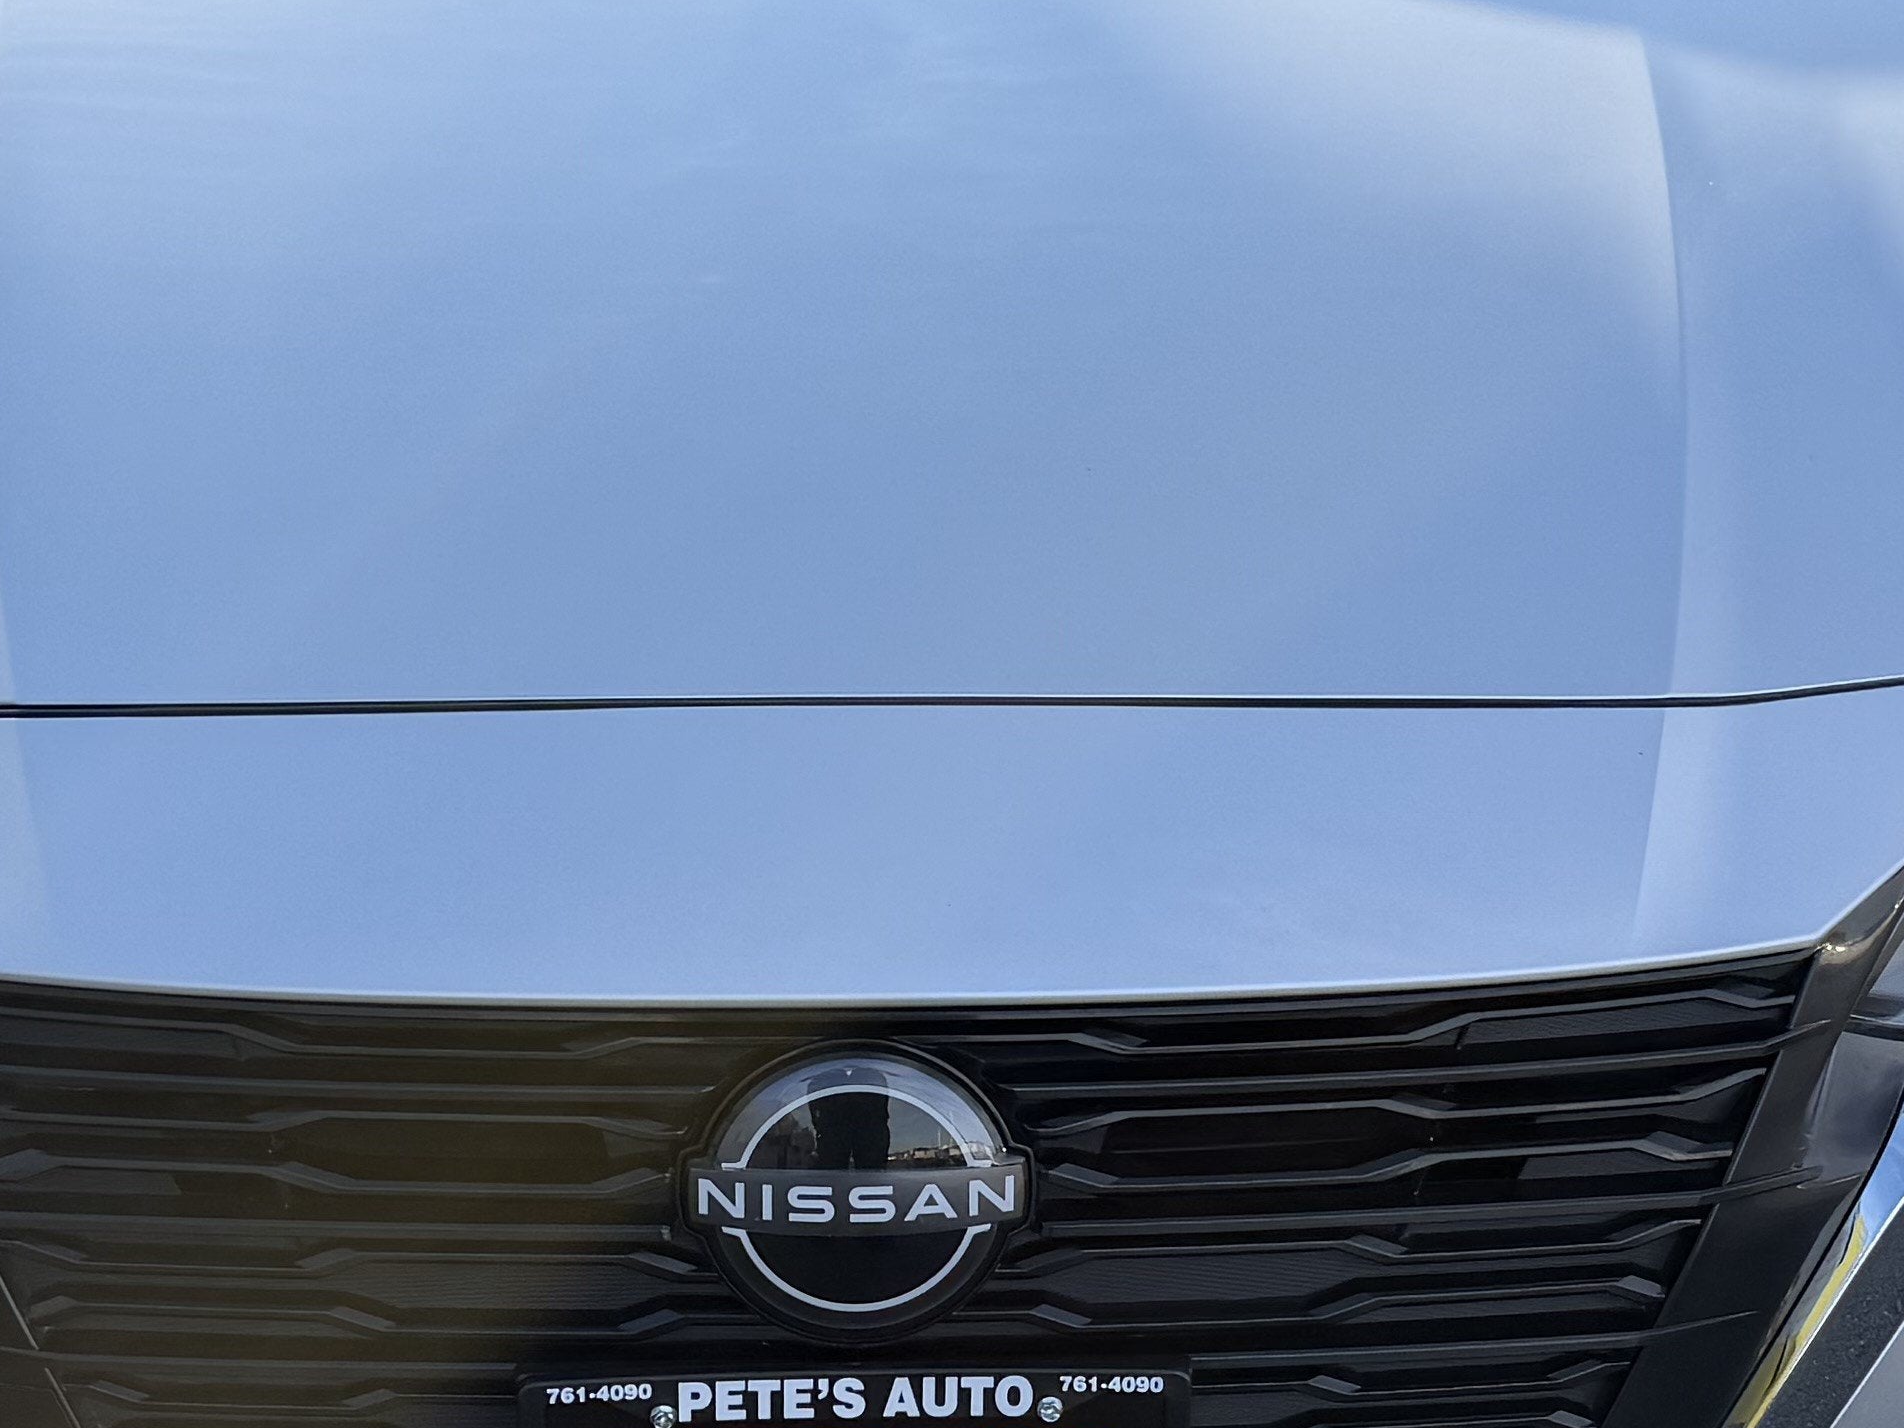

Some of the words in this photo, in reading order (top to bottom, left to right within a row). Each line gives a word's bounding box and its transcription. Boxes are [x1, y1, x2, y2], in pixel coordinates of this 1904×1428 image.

[698, 1174, 1015, 1224] NISSAN
[546, 1382, 653, 1405] 761-4090
[677, 1377, 867, 1423] PETE'S
[882, 1375, 1034, 1418] AUTO
[1059, 1374, 1165, 1395] 761-4090
